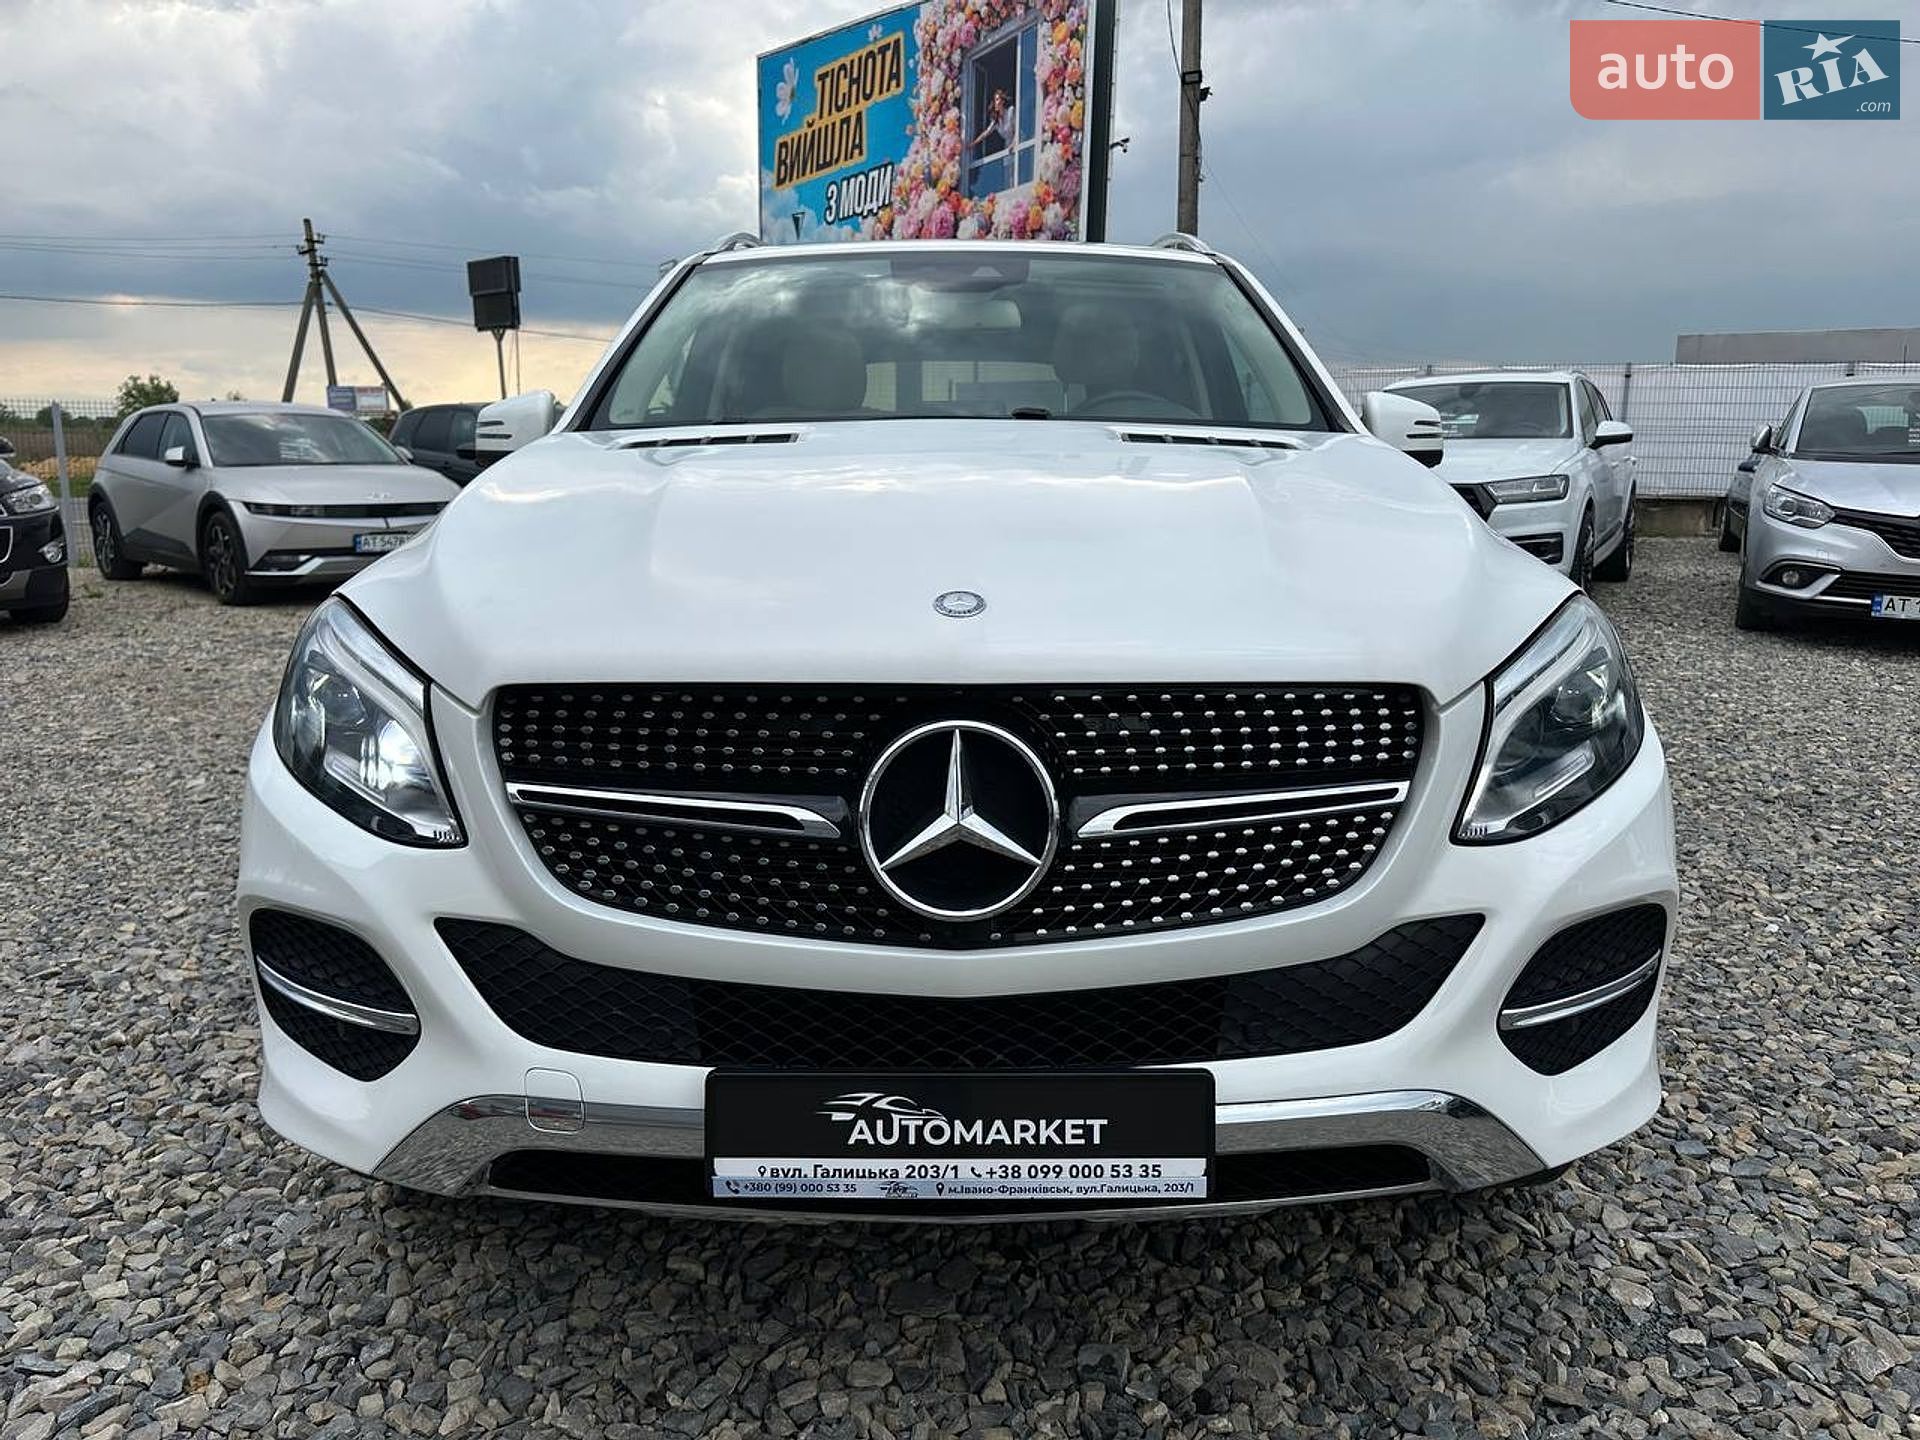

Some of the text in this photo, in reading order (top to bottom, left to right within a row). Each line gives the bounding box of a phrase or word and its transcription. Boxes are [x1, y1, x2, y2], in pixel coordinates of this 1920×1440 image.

[817, 37, 902, 119] ТІСНОТА
[776, 111, 864, 188] ВИЙШЛА
[839, 164, 893, 219] МОДИ
[1885, 598, 1912, 612] AT
[847, 1116, 1109, 1146] AUTOMARKET
[813, 1164, 900, 1179] Галицька
[905, 1164, 959, 1179] 203/1
[986, 1164, 1022, 1179] +38
[1027, 1164, 1063, 1179] 099
[1068, 1164, 1104, 1179] 000
[1110, 1164, 1133, 1179] 53
[1139, 1164, 1162, 1179] 35
[744, 1182, 772, 1193] +380
[775, 1182, 797, 1195] (99)
[800, 1183, 824, 1193] 000
[826, 1183, 840, 1193] 53
[843, 1183, 857, 1193] 35
[1164, 1182, 1194, 1194] 203/1
